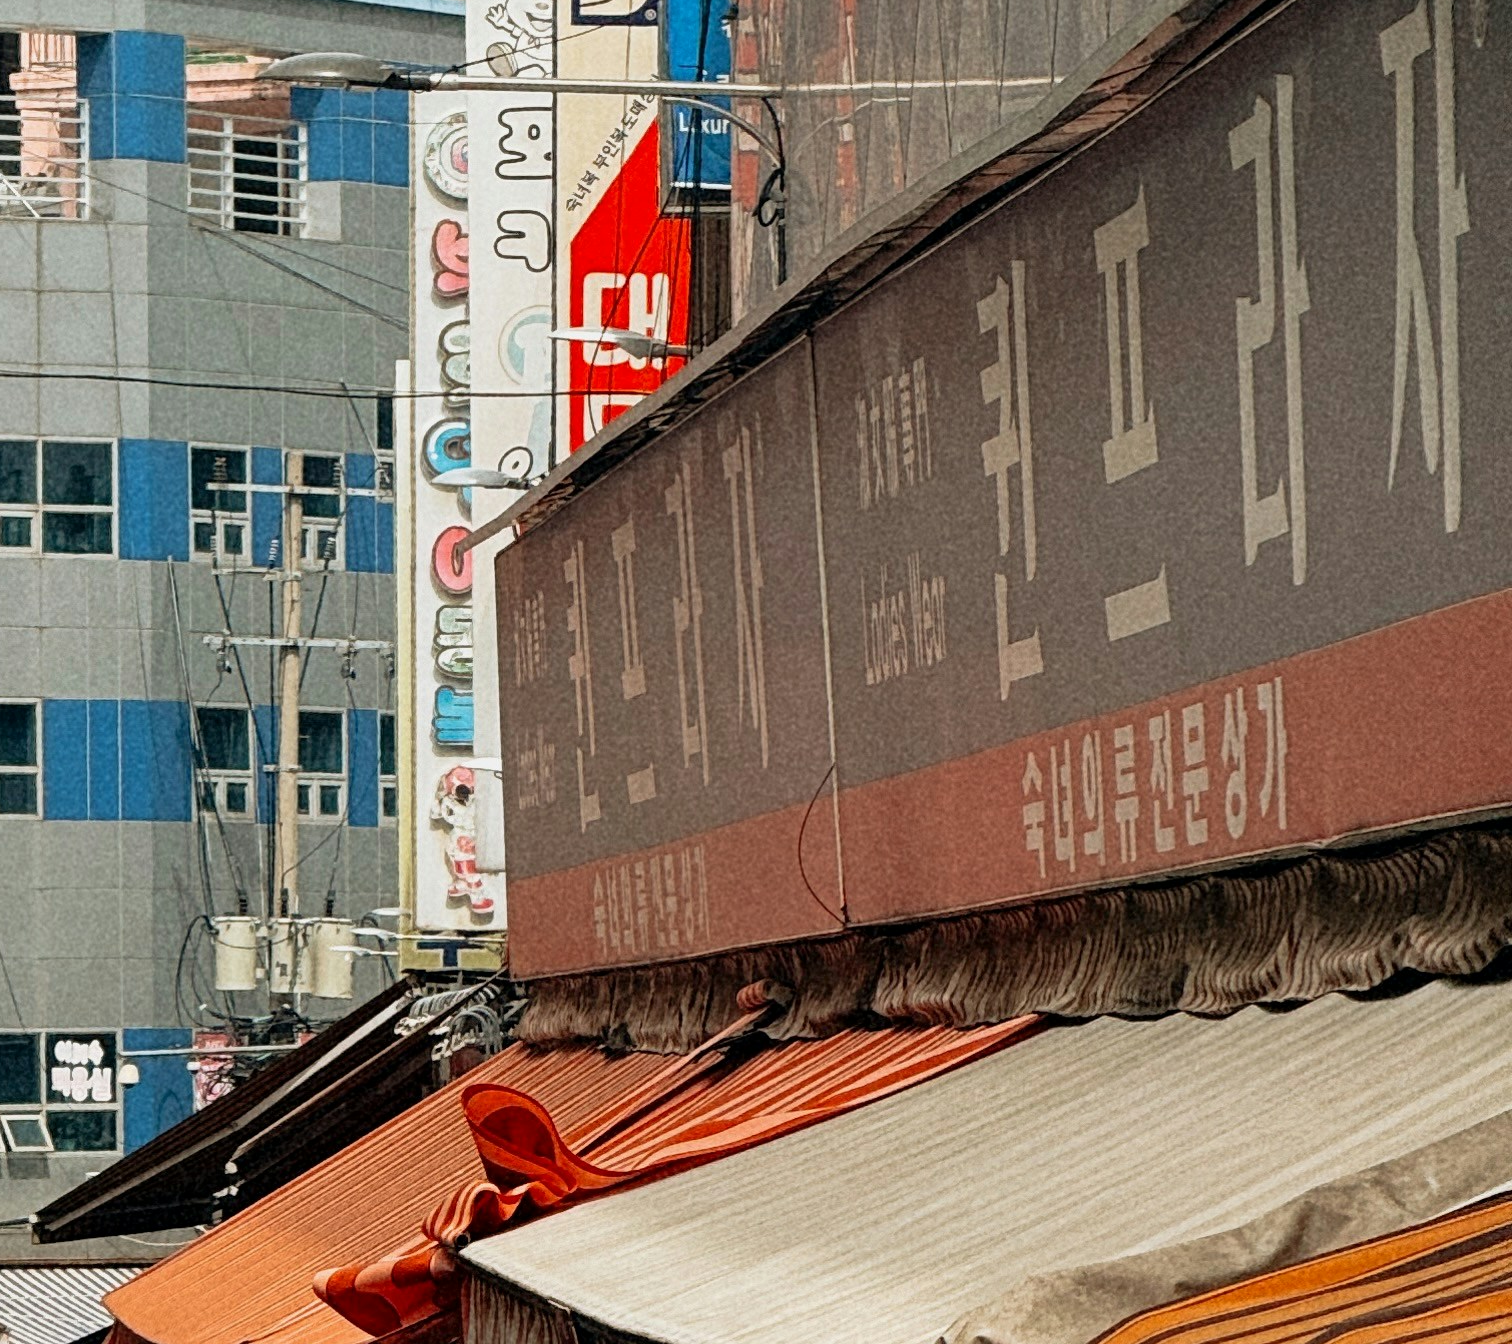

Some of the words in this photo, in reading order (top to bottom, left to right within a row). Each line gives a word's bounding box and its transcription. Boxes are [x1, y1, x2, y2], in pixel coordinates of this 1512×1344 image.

[566, 169, 600, 212] 숙녀복
[592, 127, 629, 169] 부인복
[1020, 676, 1289, 880] 숙녀의류전문상가
[592, 842, 711, 956] 숙녀의류전문상가
